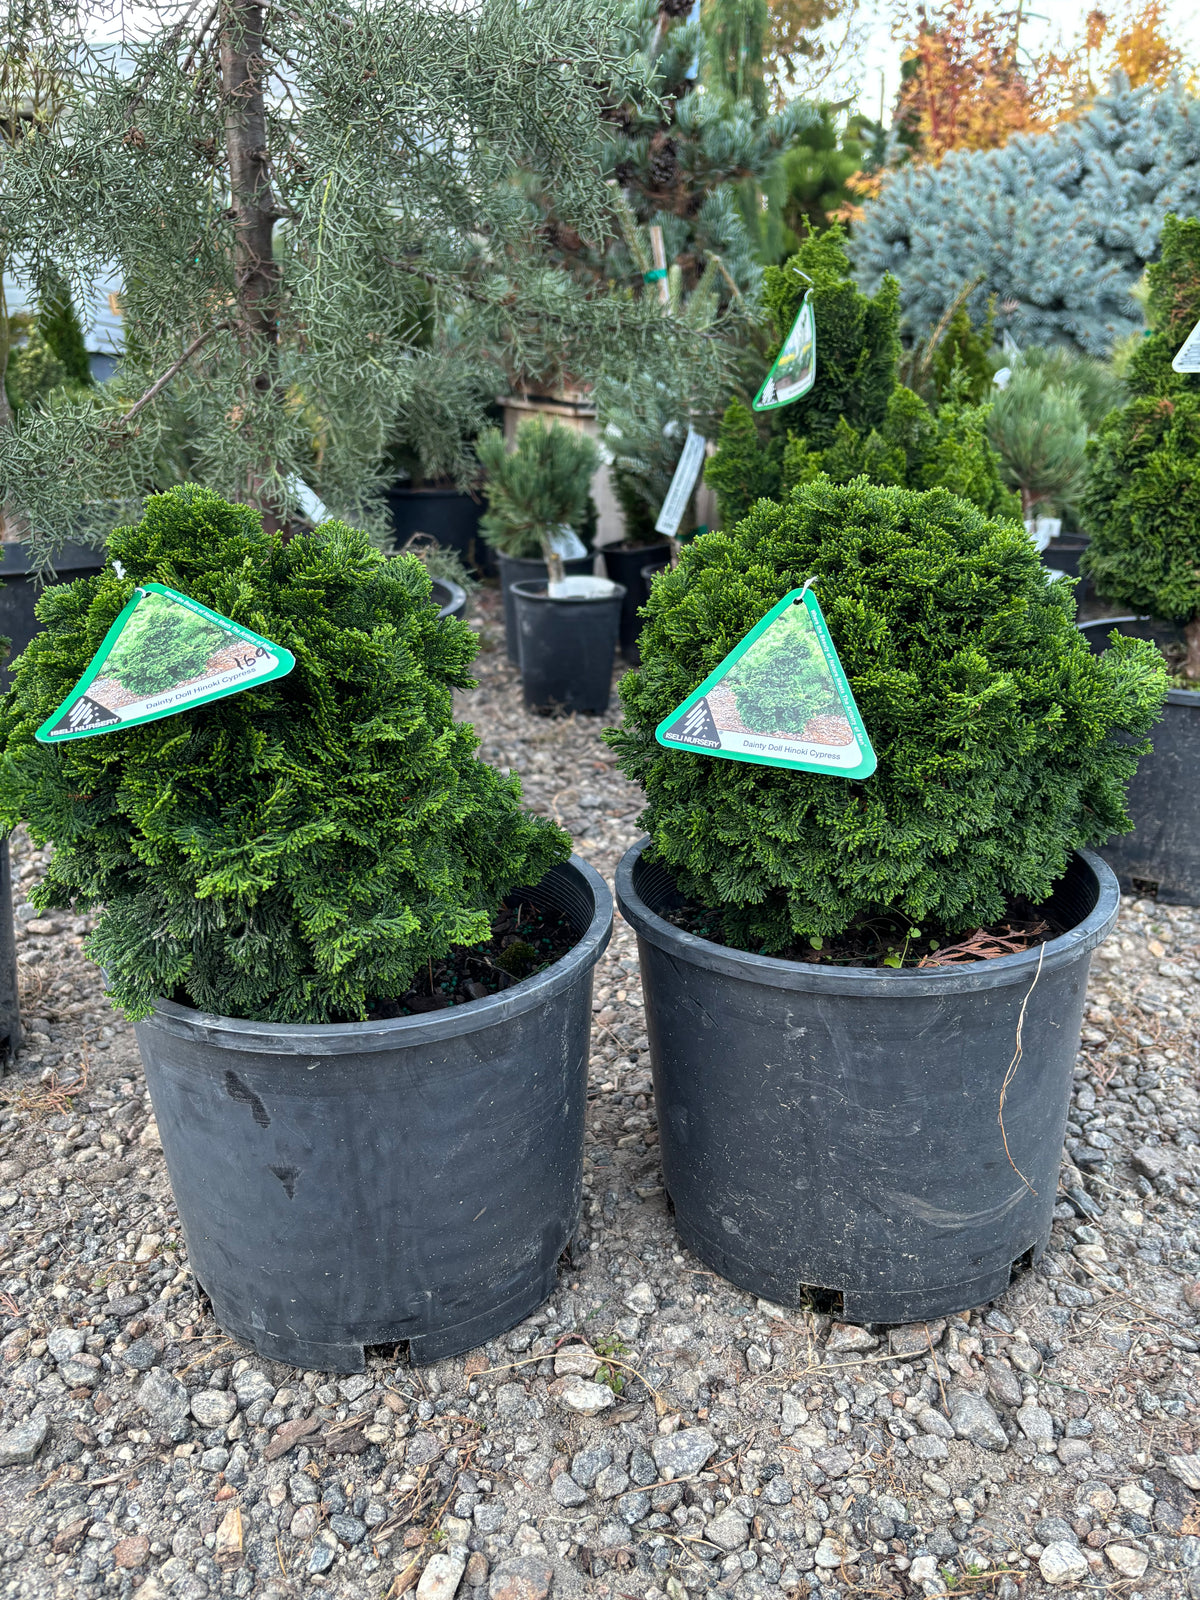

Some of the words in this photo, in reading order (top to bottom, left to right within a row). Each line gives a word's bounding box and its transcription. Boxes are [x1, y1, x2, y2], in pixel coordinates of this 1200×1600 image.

[810, 609, 819, 625] Where
[819, 634, 830, 653] Beauty
[829, 659, 839, 677] Nature
[234, 647, 270, 670] 169
[145, 696, 173, 710] Dainty
[175, 689, 192, 700] Doll
[193, 680, 220, 695] Hinoki
[221, 667, 257, 683] Cypress
[74, 717, 120, 733] NURSERY
[665, 732, 683, 743] ISELI
[683, 734, 720, 748] NURSERY
[743, 740, 767, 751] Dainty
[768, 743, 783, 752] Doll
[784, 745, 808, 756] Hinoki
[810, 749, 841, 761] Cypress
